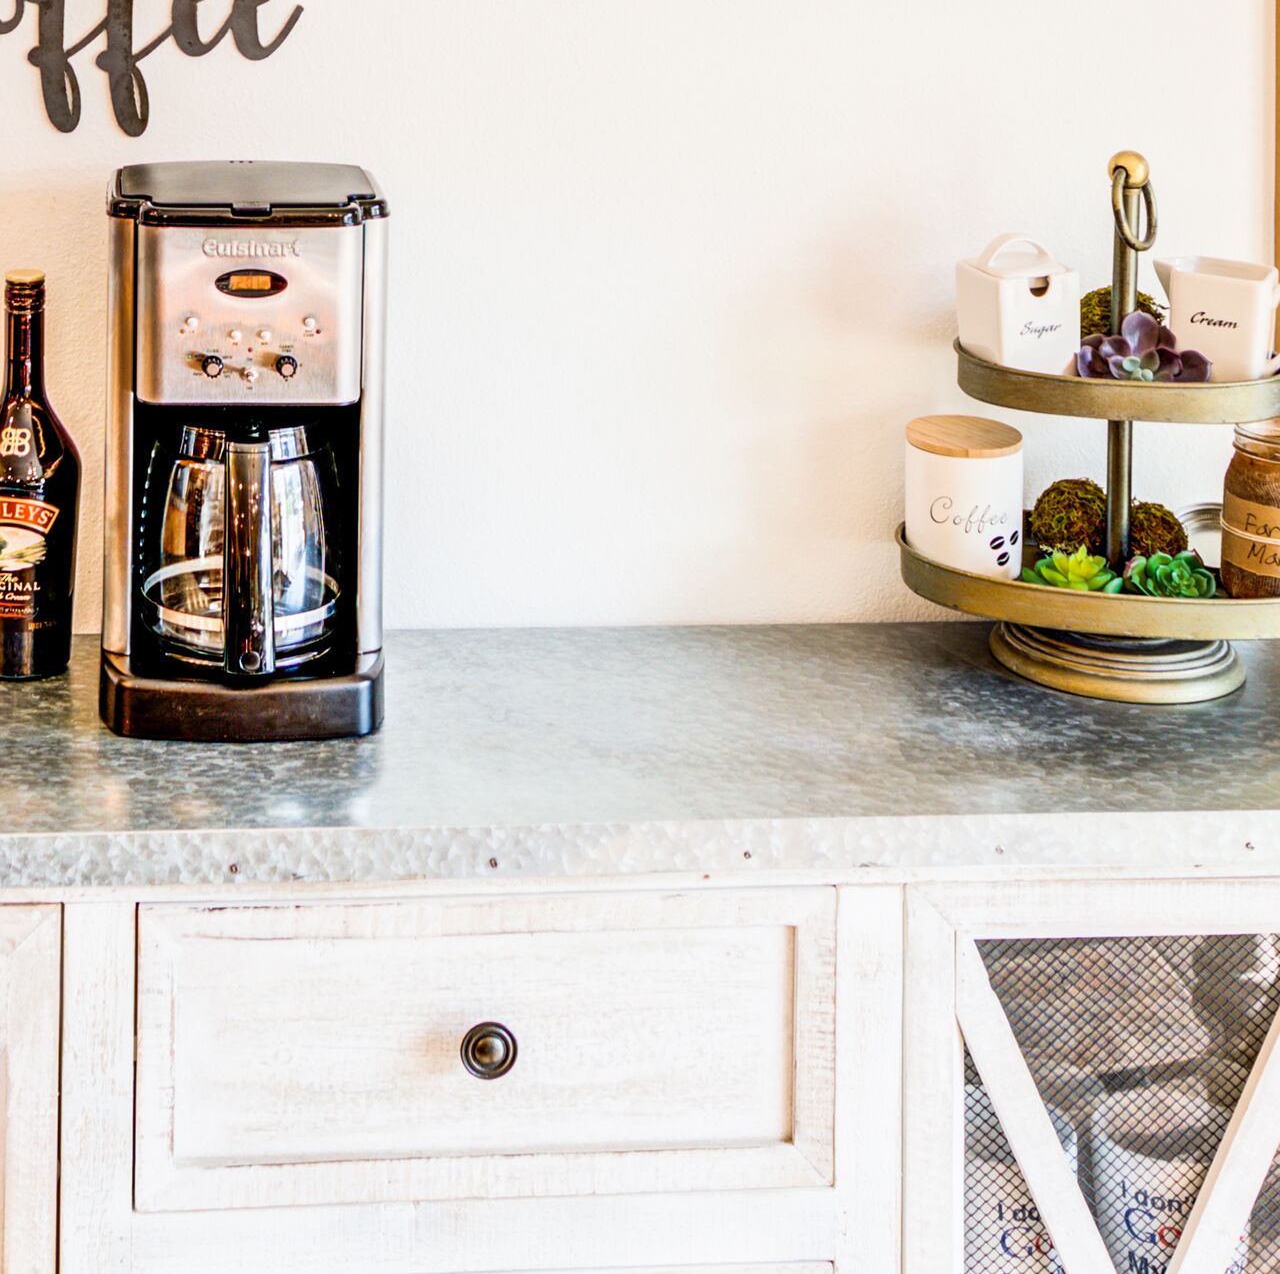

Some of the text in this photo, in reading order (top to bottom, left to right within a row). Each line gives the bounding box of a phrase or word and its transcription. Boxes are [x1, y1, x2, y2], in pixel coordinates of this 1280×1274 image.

[202, 238, 300, 258] Cuisinart
[1190, 311, 1239, 329] Cream
[1020, 321, 1062, 339] Sugar
[929, 495, 1008, 533] Coffee
[5, 592, 32, 601] Cream
